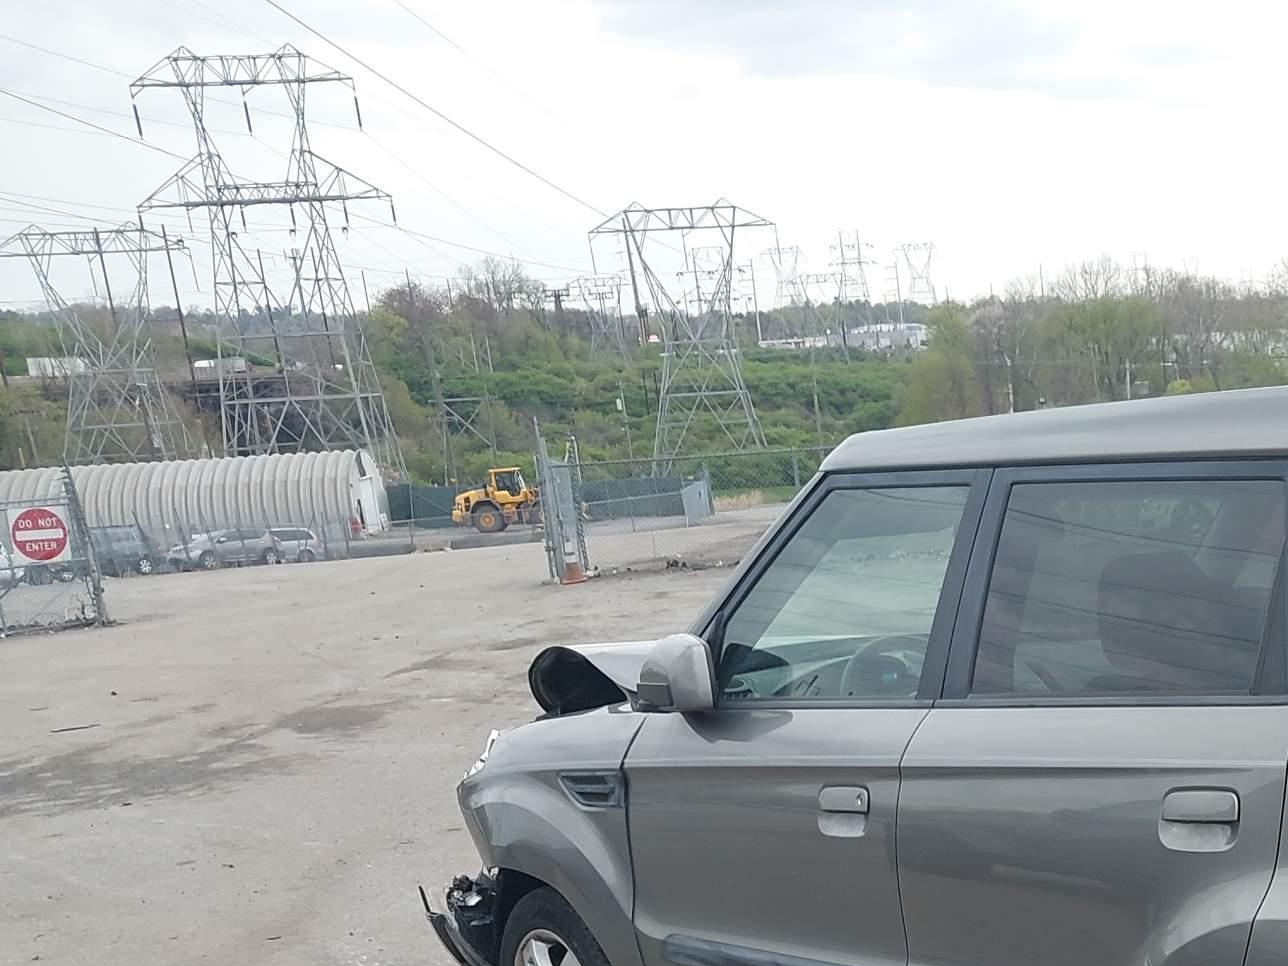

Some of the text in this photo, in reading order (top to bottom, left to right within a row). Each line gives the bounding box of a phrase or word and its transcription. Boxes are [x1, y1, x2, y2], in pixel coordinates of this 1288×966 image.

[18, 517, 57, 529] DO NOT
[26, 541, 57, 552] ENTER
